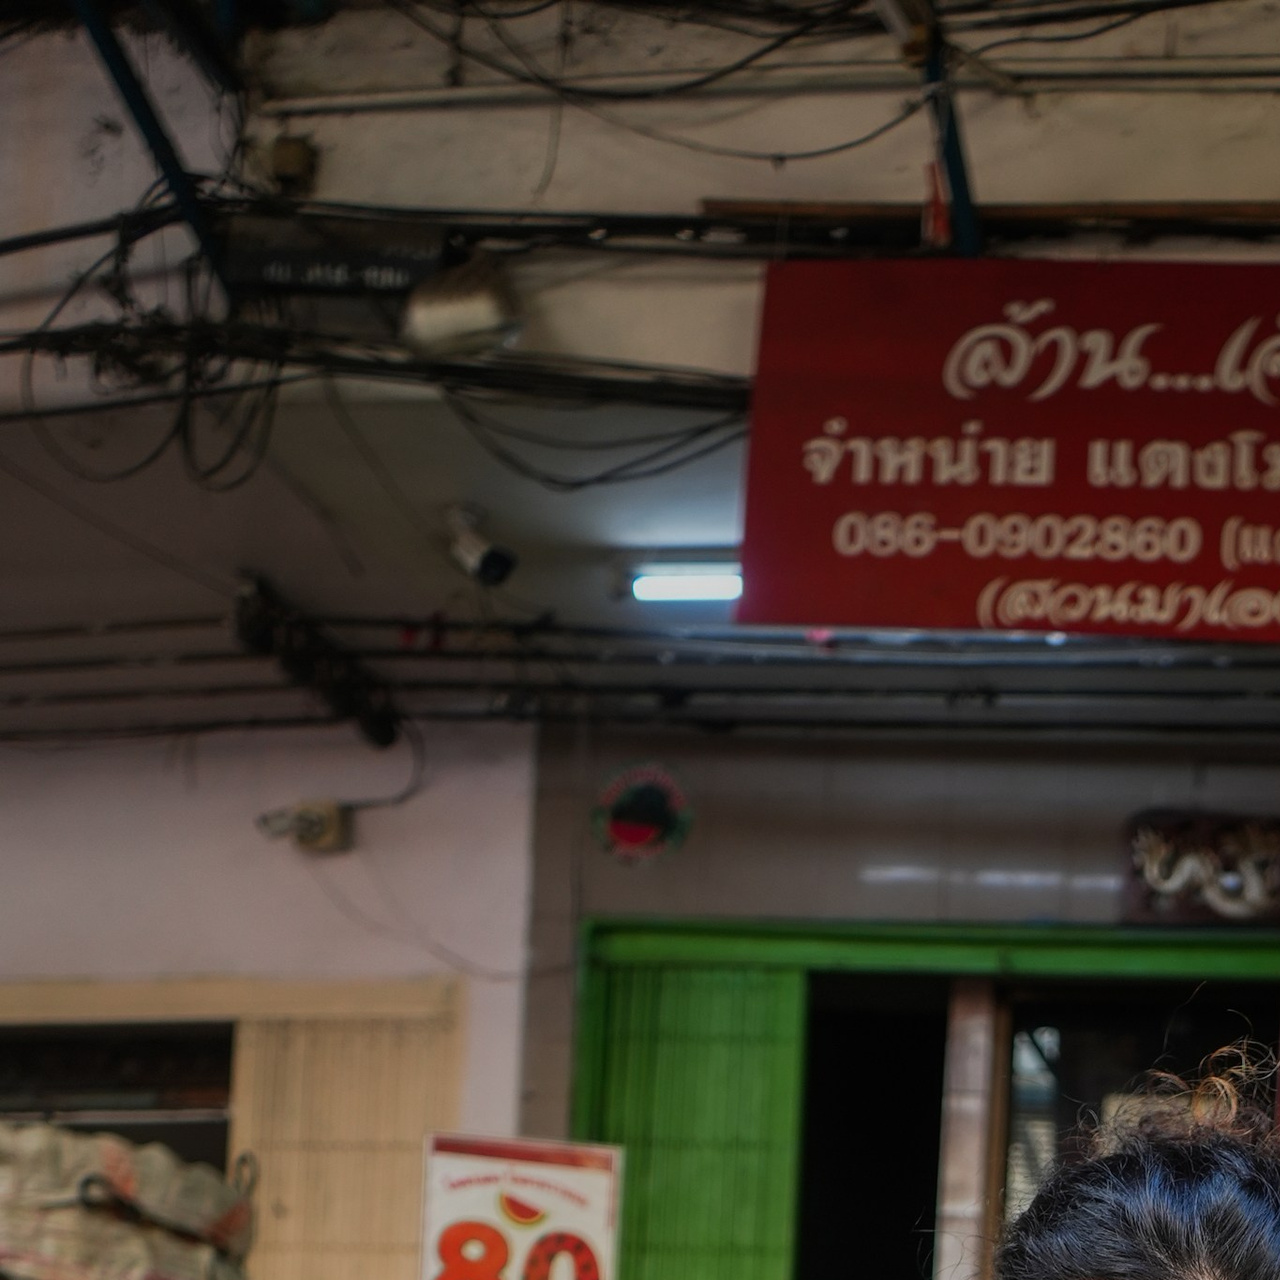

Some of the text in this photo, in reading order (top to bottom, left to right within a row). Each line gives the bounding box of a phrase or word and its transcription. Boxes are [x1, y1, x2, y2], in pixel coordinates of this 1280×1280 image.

[803, 417, 1057, 486] จำหน่าย
[832, 511, 1202, 562] 086-0902860
